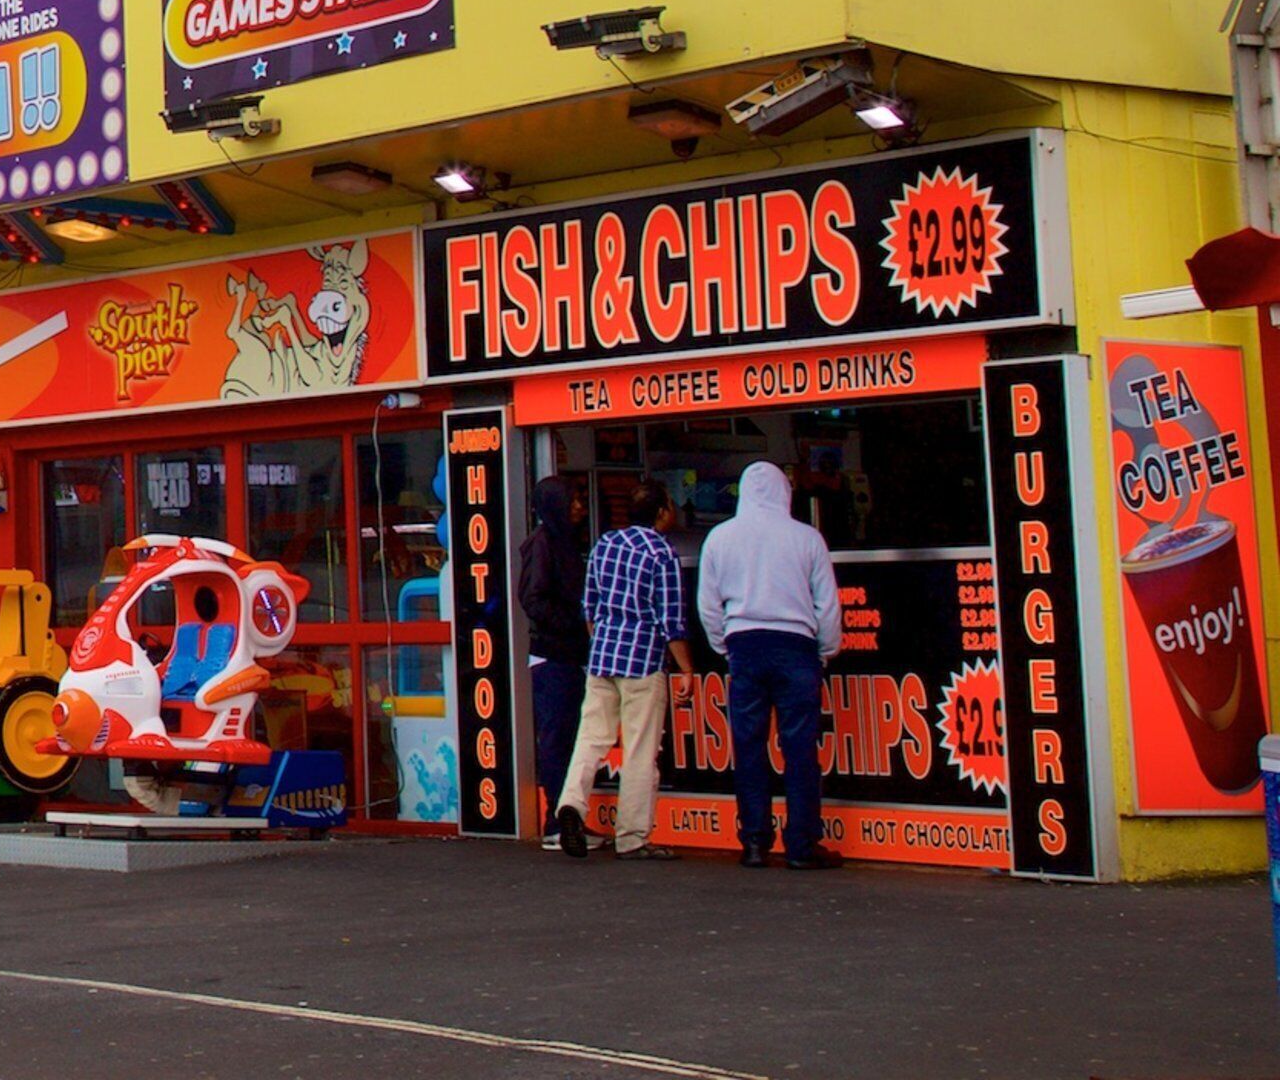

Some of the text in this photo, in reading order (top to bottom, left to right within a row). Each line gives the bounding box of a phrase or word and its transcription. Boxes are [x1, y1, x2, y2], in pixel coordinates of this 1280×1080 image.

[21, 8, 58, 36] RIDES
[907, 203, 986, 280] £2.99
[89, 283, 198, 346] South
[568, 350, 915, 413] TEA COFFEE COLD DRINKS
[1130, 369, 1199, 430] TEA
[449, 426, 501, 452] JUMBO
[148, 479, 190, 508] DEAD
[1118, 430, 1246, 513] COFFEE
[467, 465, 489, 603] HOT
[844, 610, 881, 627] CHIPS
[1011, 383, 1066, 857] BURGERS
[1154, 587, 1245, 656] enjoy!
[473, 629, 496, 820] DOGS
[669, 671, 736, 773] FIS
[861, 820, 900, 843] HOT
